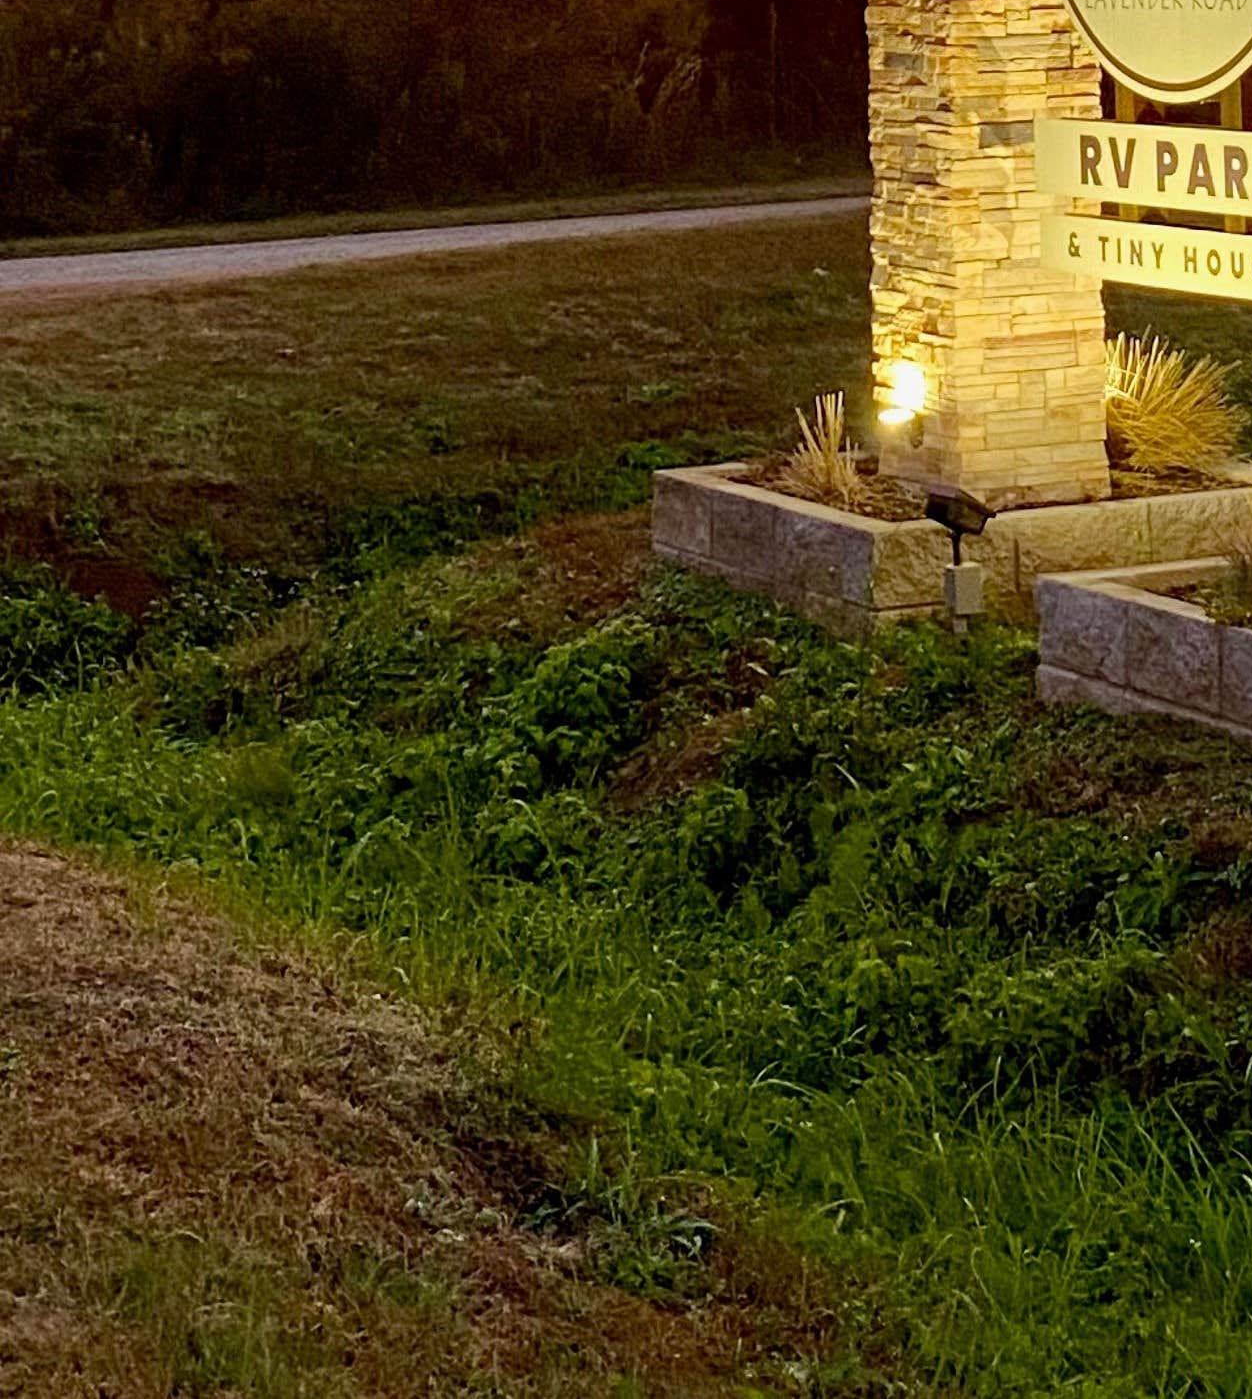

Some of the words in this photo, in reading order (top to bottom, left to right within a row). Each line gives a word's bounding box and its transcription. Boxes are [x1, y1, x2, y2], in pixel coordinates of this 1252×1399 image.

[1079, 134, 1137, 189] RV
[1067, 231, 1082, 259] &
[1098, 235, 1165, 270] TINY
